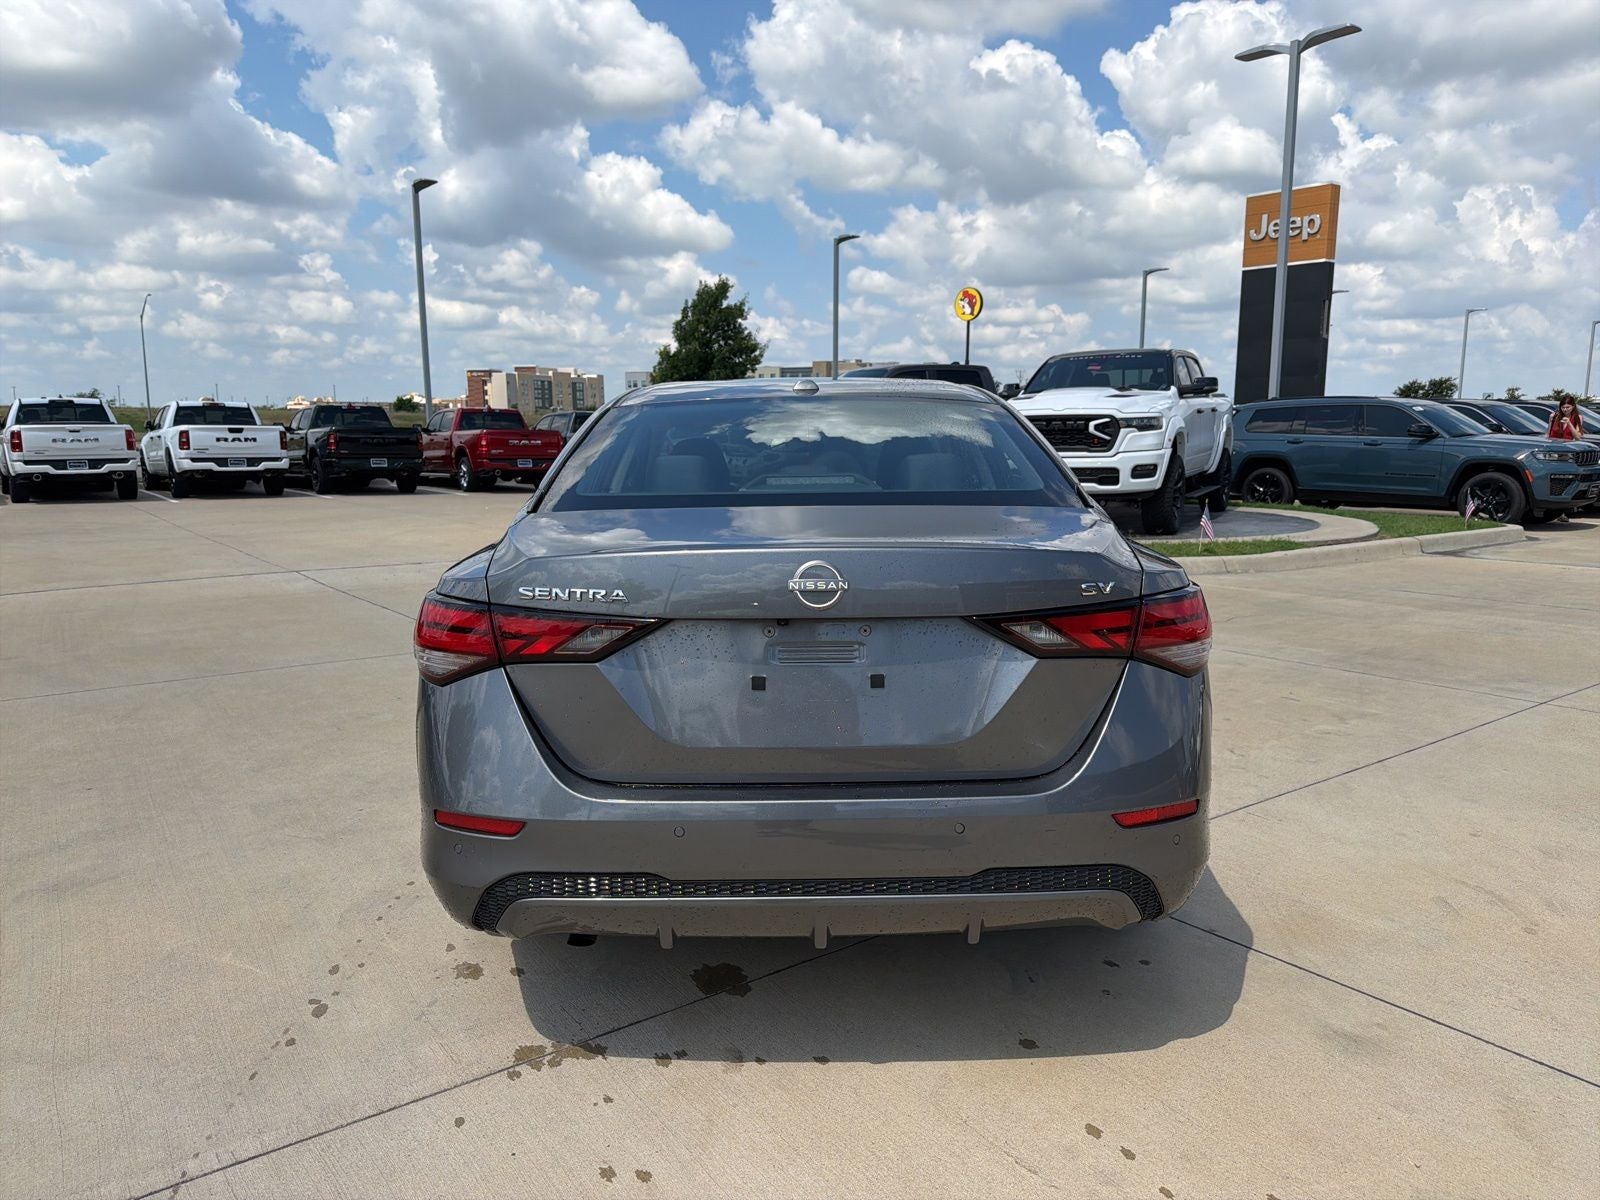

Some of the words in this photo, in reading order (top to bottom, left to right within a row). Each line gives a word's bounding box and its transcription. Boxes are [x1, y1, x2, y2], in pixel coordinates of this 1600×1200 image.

[1249, 213, 1321, 241] Jeep
[789, 581, 848, 590] NISSAN
[1081, 581, 1115, 596] SV
[518, 586, 629, 603] SENTRA
